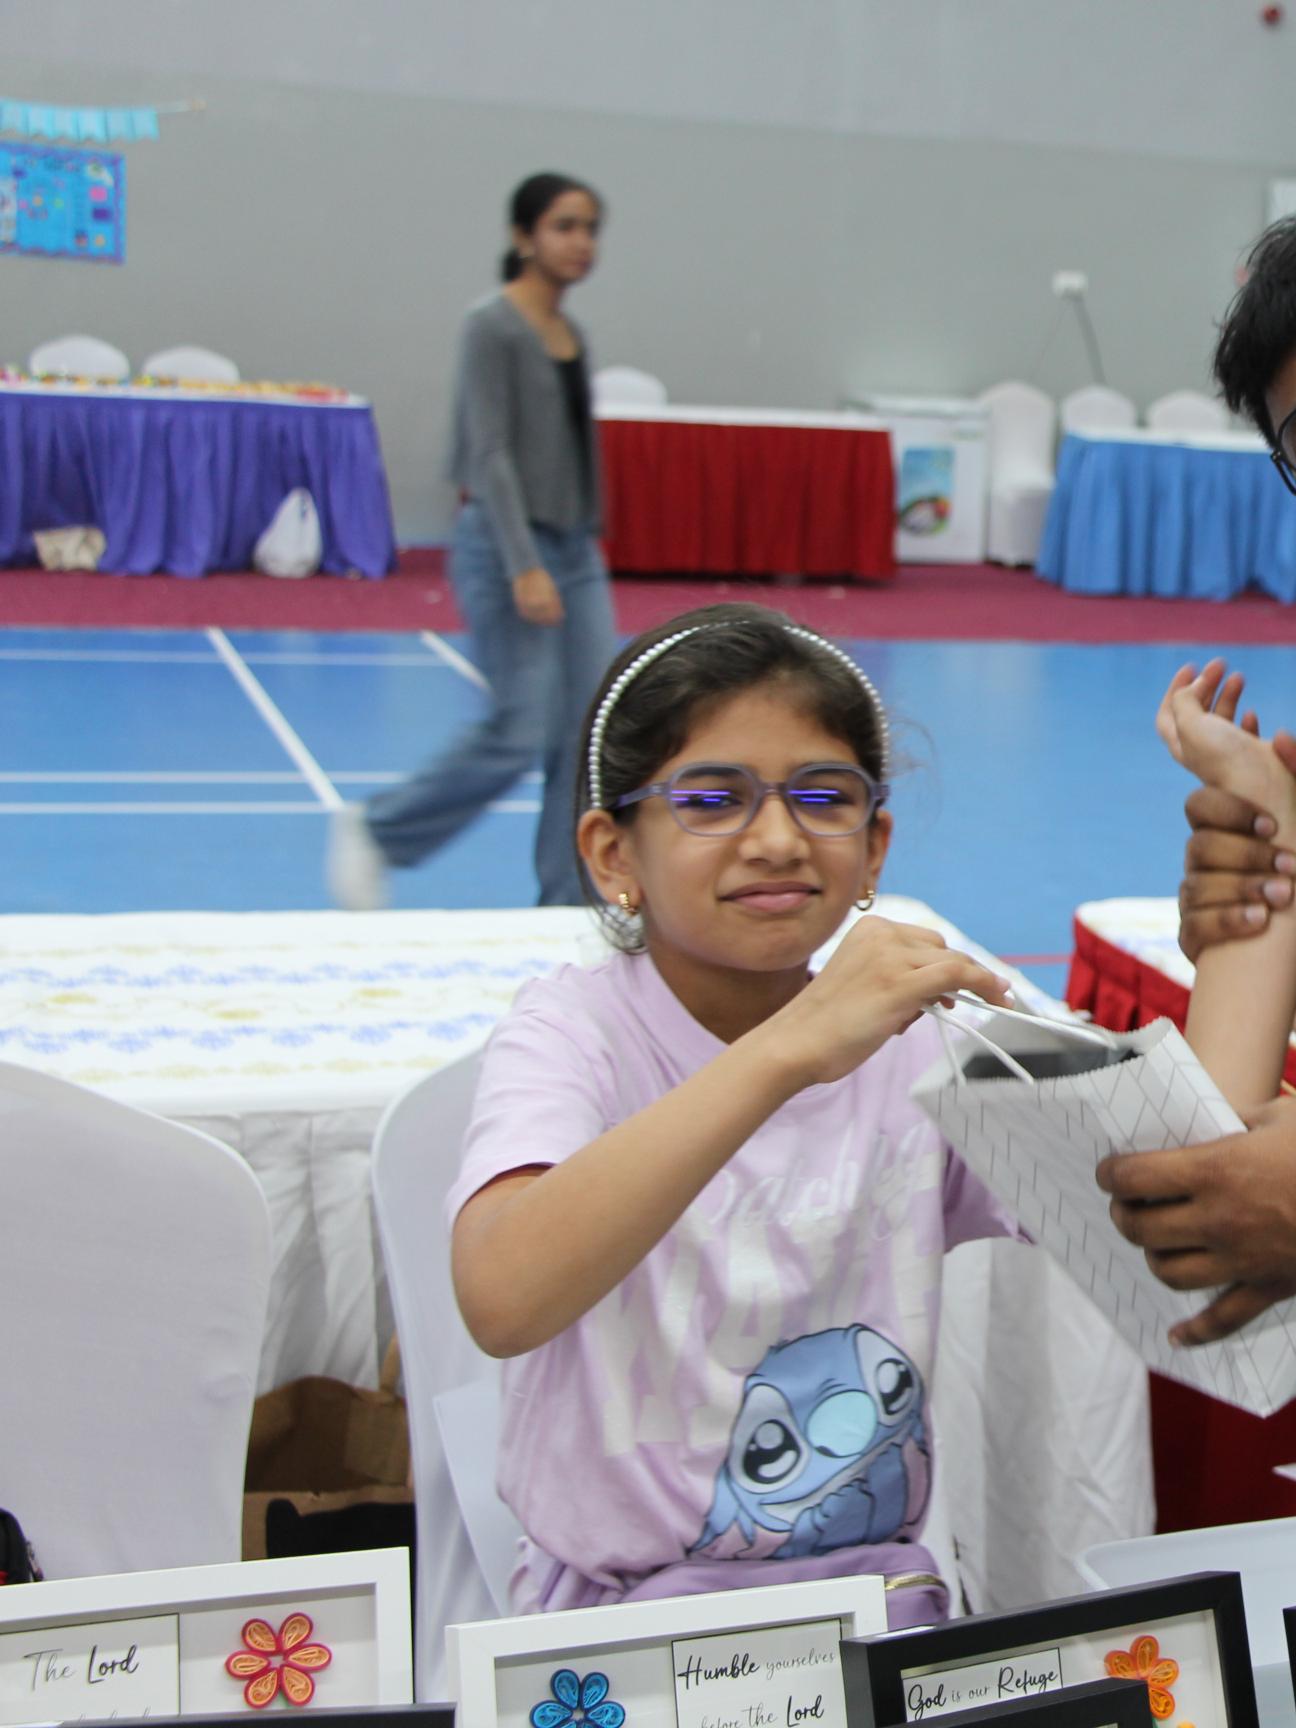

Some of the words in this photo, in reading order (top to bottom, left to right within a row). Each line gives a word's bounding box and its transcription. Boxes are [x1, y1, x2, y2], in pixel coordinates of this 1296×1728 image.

[22, 1648, 76, 1692] The
[87, 1644, 140, 1684] Lord
[677, 1652, 760, 1690] Humble
[766, 1648, 836, 1680] yourselves
[741, 1702, 779, 1726] the
[786, 1694, 825, 1728] Lord
[907, 1683, 947, 1721] God
[951, 1689, 962, 1703] is
[968, 1685, 991, 1700] our
[997, 1666, 1059, 1699] Refuge
